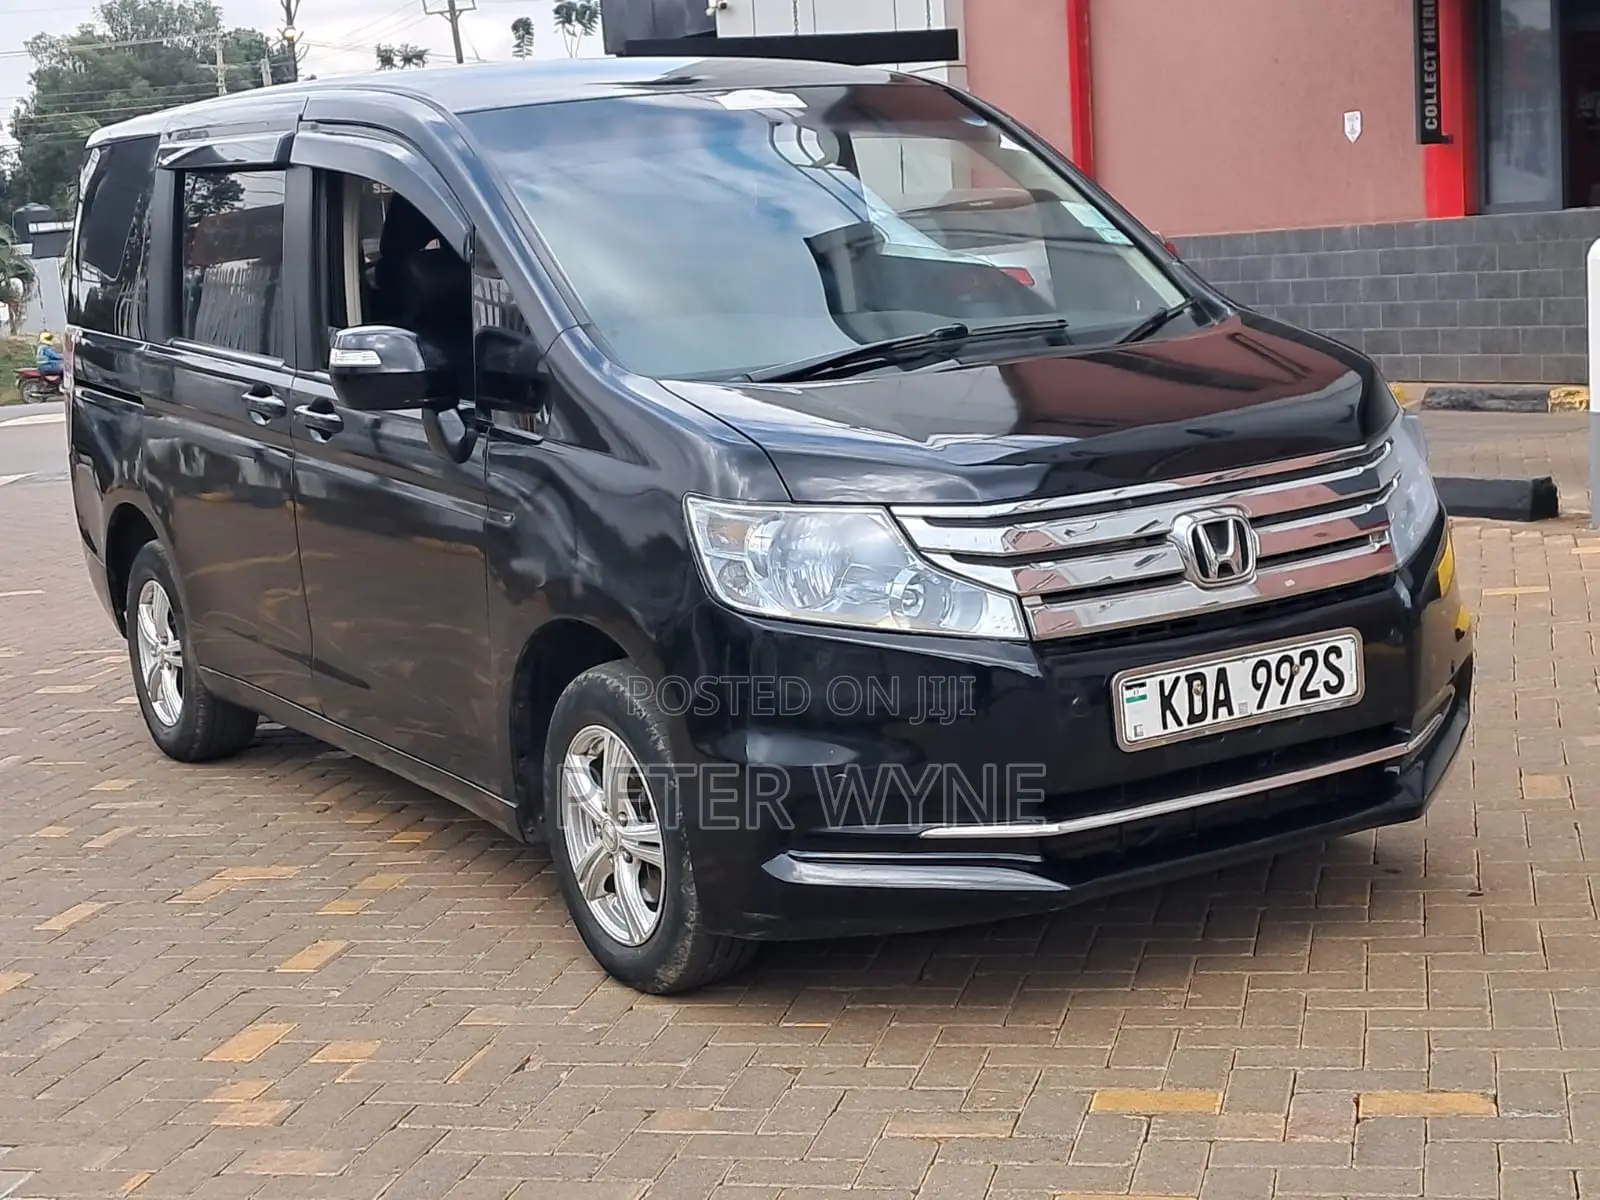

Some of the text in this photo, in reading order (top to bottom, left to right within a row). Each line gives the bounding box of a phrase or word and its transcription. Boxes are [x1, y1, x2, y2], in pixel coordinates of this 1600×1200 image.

[1424, 48, 1438, 130] COLLECT
[1158, 645, 1345, 730] KDA 992S
